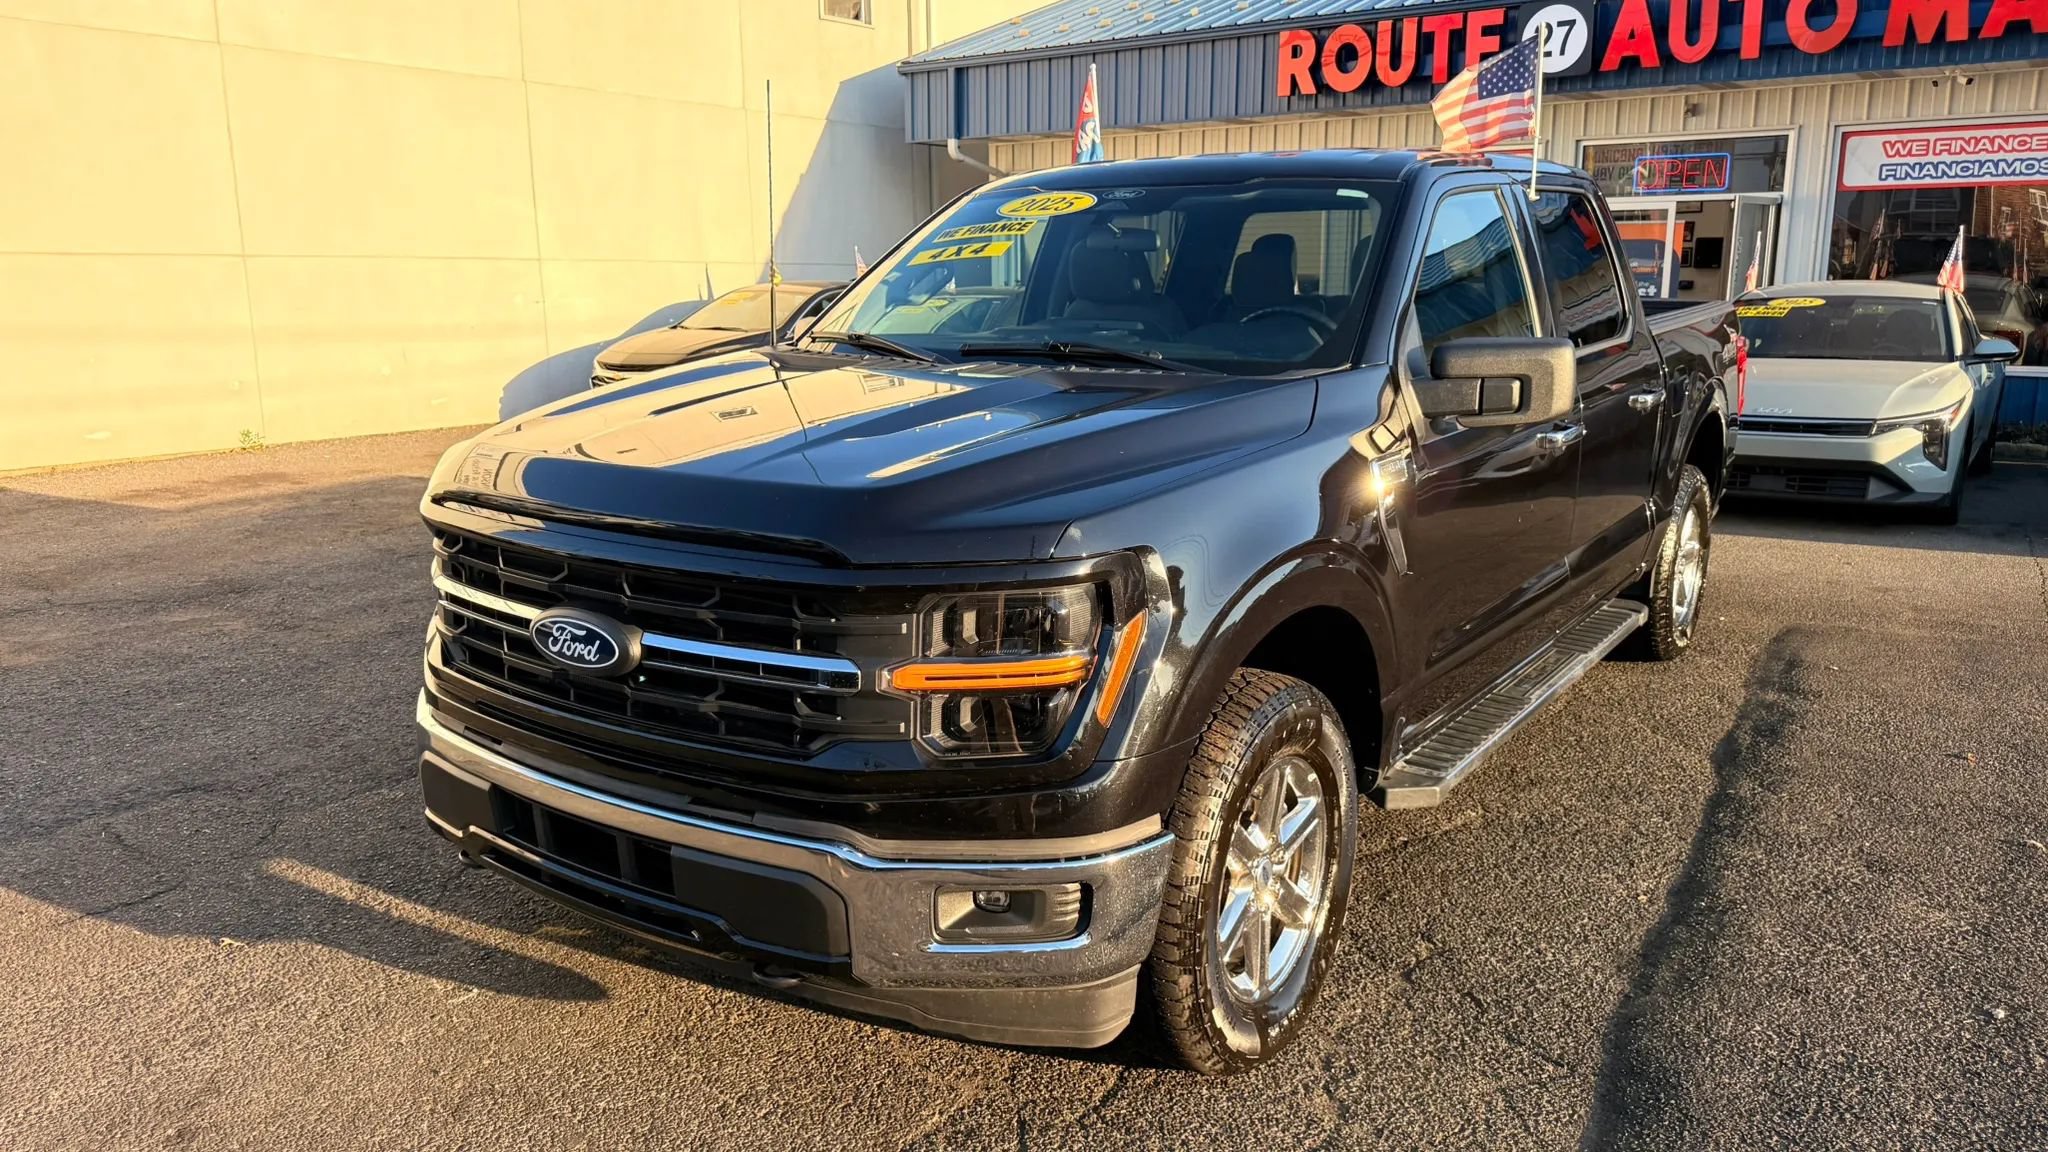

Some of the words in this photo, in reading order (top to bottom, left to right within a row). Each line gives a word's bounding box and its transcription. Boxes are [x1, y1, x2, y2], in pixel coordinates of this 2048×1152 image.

[1277, 8, 1506, 97] ROUTE
[1600, 0, 1859, 72] AUTO
[1882, 139, 1930, 158] WE
[1933, 133, 2048, 156] FINANCE
[1636, 157, 1730, 190] OPEN
[1879, 157, 2048, 181] FINANCIAMOS
[1007, 196, 1085, 214] 2025
[937, 227, 963, 241] WE
[959, 220, 1035, 237] FINANCE
[548, 623, 601, 662] Ford
